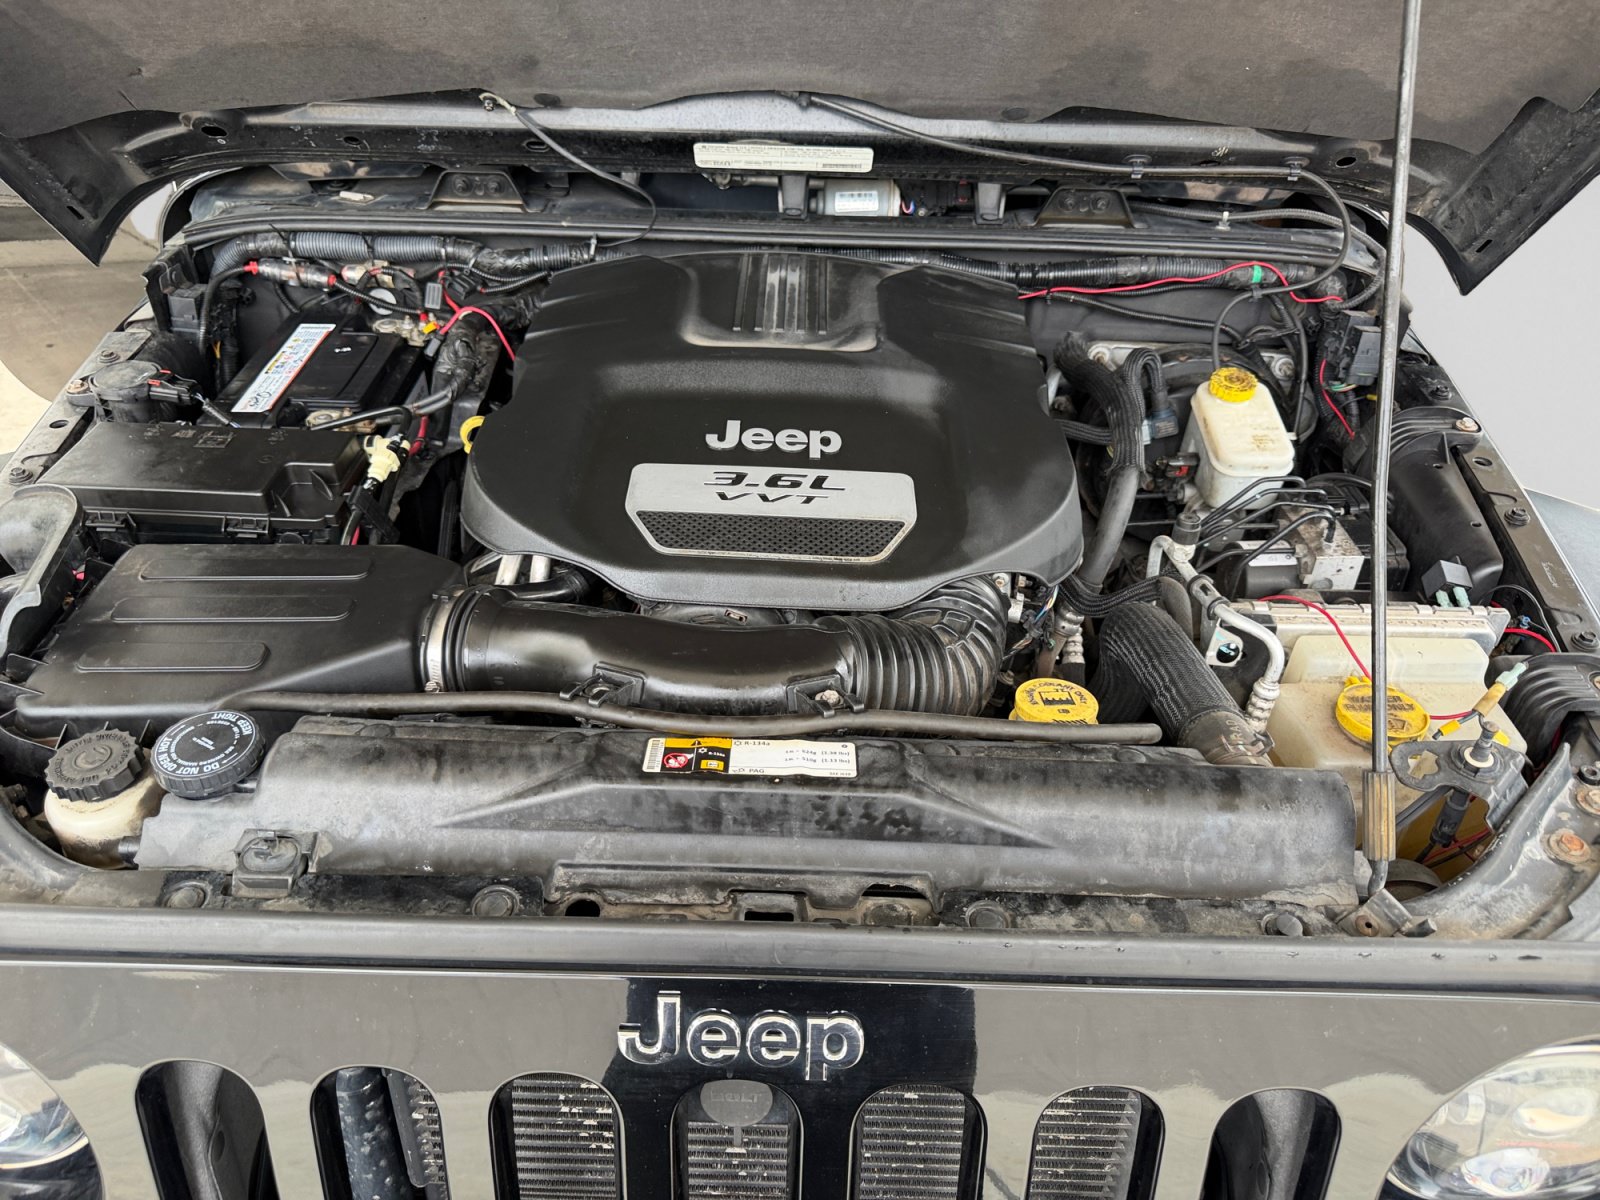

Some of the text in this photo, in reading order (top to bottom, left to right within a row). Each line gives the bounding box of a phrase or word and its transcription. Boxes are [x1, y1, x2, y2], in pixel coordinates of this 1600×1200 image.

[705, 420, 842, 459] Jeep
[704, 471, 846, 492] 3.6L
[715, 491, 829, 505] VVT
[211, 712, 240, 721] TIGHT
[236, 719, 253, 736] KEEP
[157, 736, 220, 775] DO NOT OPEN HOT
[617, 990, 865, 1081] Jeep
